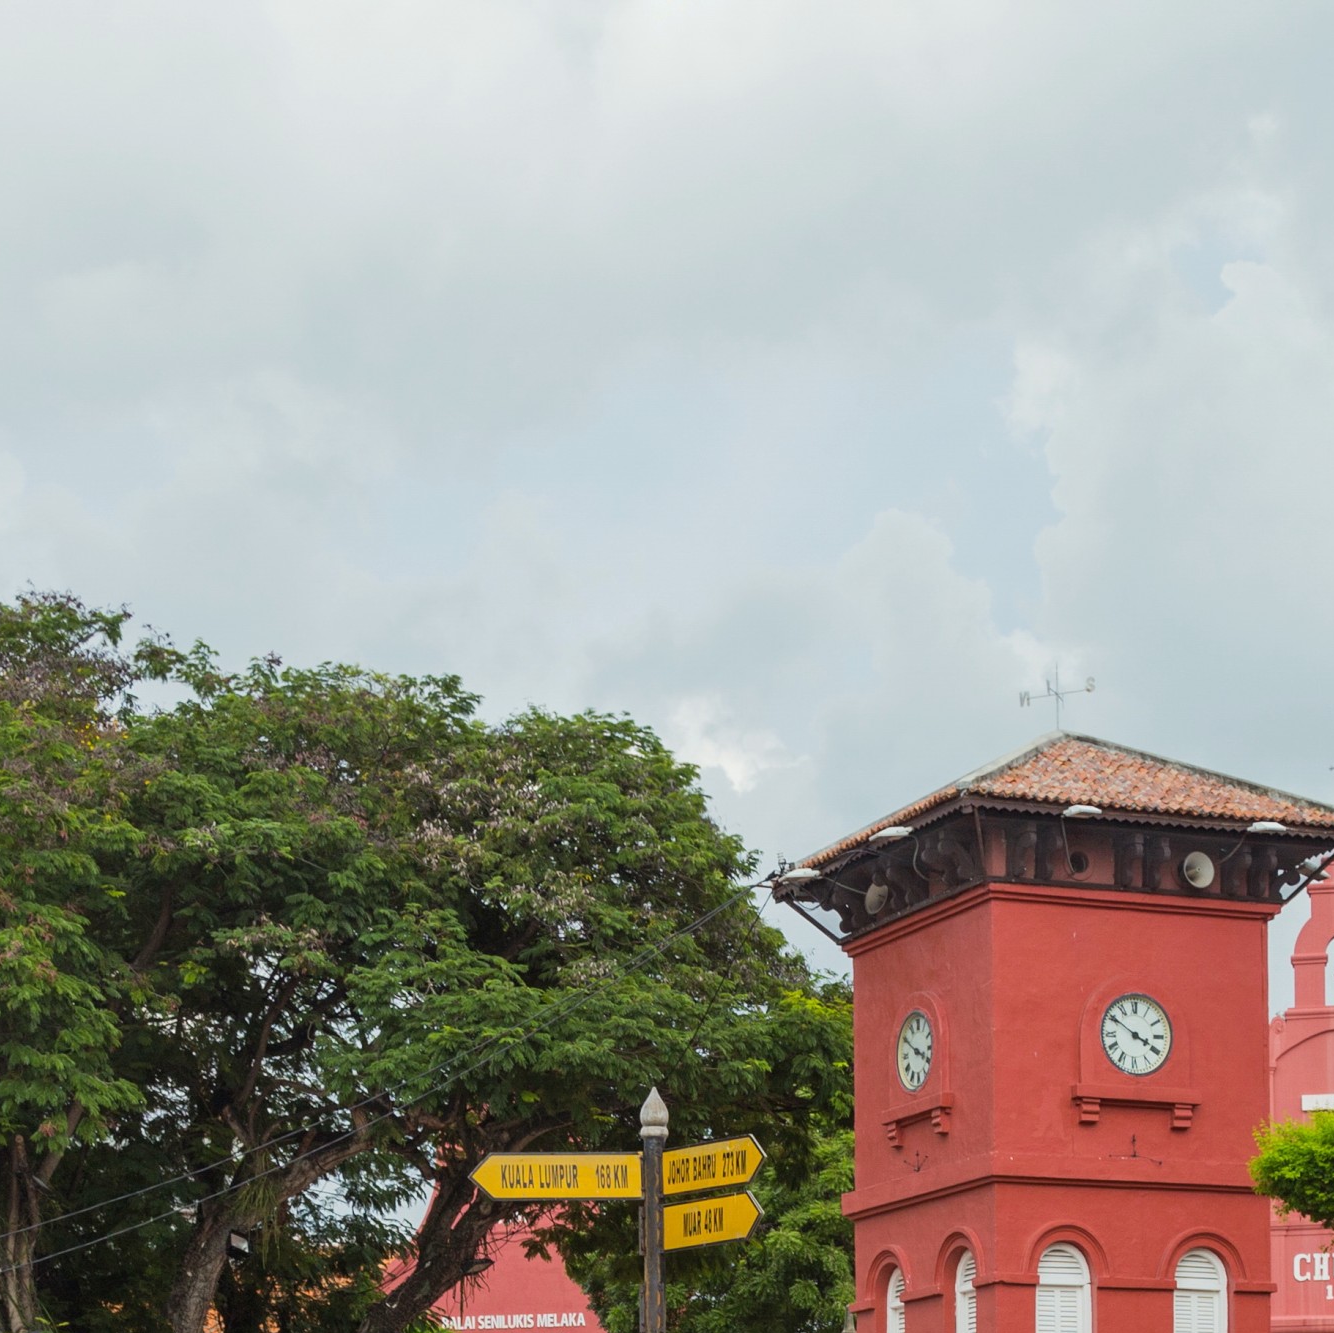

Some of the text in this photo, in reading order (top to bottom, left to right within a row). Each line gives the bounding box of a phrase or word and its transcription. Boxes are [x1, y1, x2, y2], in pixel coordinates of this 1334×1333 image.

[500, 1164, 629, 1189] KUALA LUMPUR 168 KM
[668, 1150, 747, 1185] JOHOR BAHRU 273 KM
[683, 1207, 723, 1238] MUAR 48 KM
[537, 1312, 586, 1328] MELAKA
